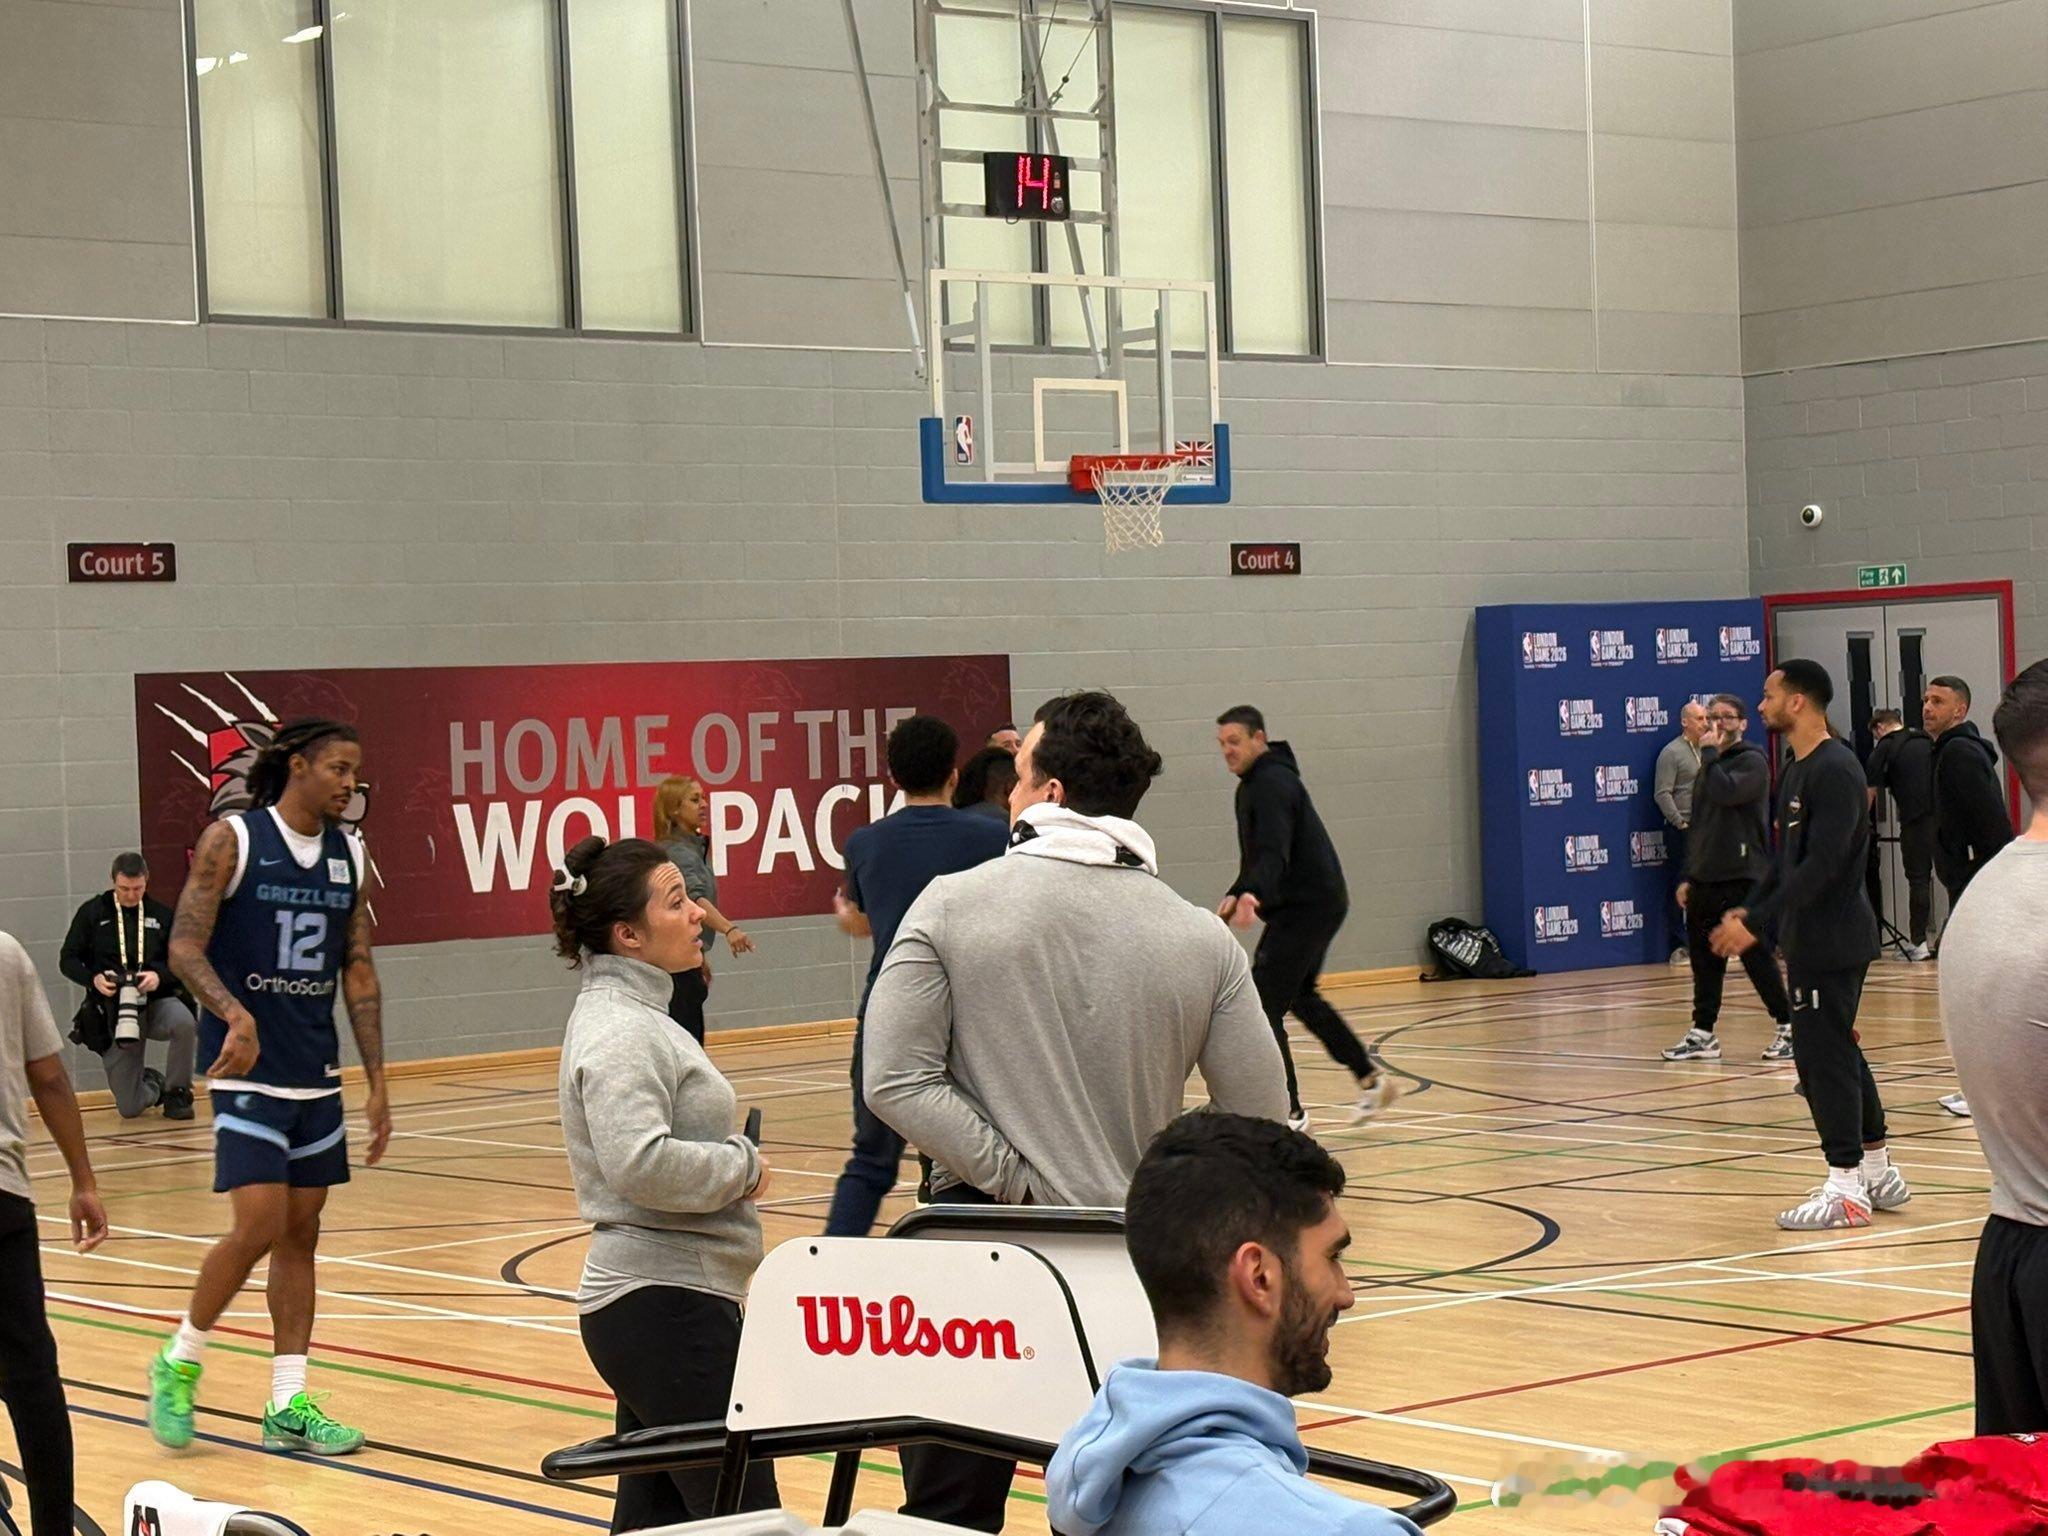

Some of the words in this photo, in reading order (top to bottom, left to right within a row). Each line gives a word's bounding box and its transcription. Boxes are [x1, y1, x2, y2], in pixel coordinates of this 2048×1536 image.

[1017, 156, 1051, 209] 14
[79, 551, 145, 576] Court
[151, 552, 165, 576] 5
[1237, 550, 1281, 570] Court
[1284, 550, 1295, 570] 4
[449, 714, 674, 796] HOME
[691, 711, 780, 785] OF
[256, 883, 352, 909] GRIZZLIES
[274, 910, 328, 971] 12
[796, 1295, 1021, 1360] Wilson
